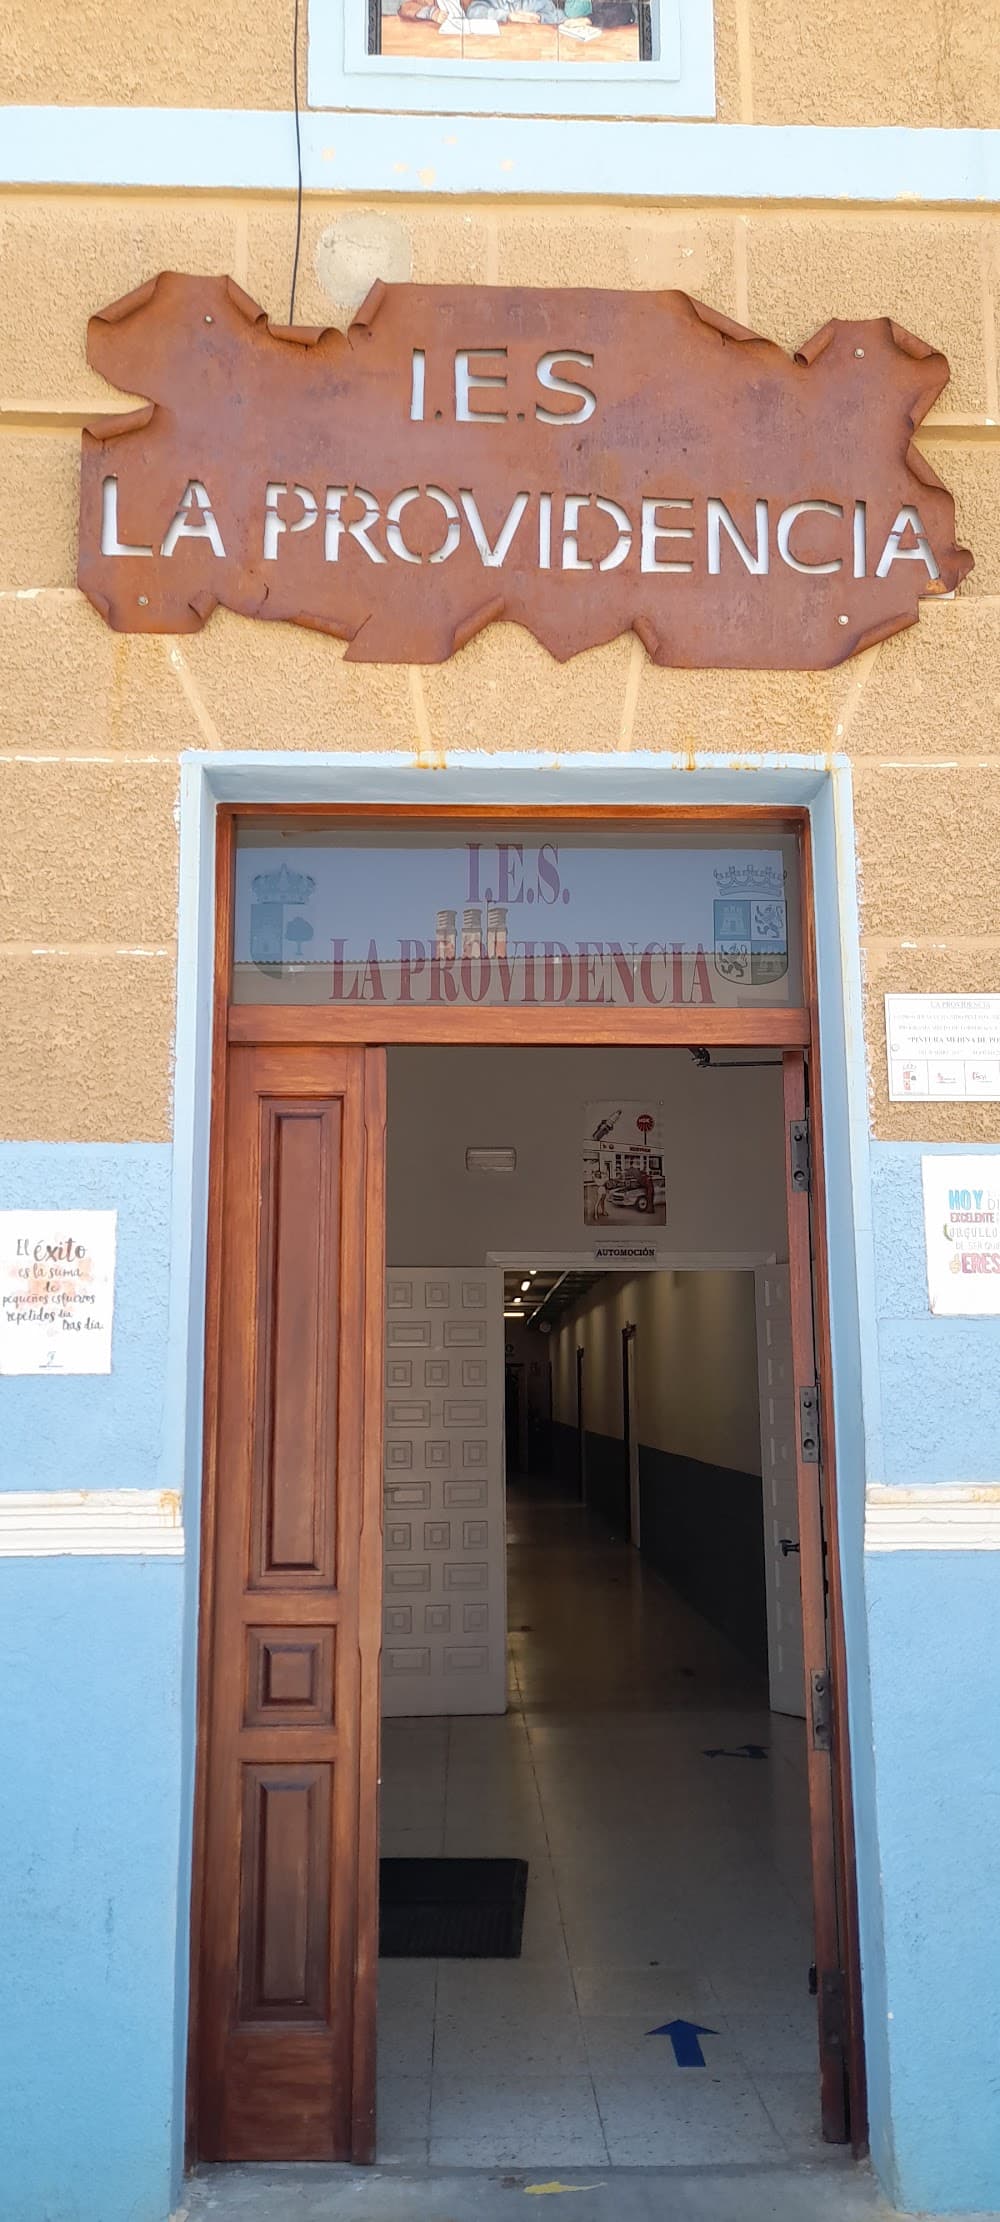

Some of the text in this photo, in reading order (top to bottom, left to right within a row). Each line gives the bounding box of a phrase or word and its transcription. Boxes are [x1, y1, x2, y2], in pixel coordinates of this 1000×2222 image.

[410, 347, 597, 426] I.E.S
[101, 474, 941, 580] LA PROVIDENCIA
[464, 841, 571, 905] I.E.S.
[328, 936, 717, 1005] LA PROVIDENCIA
[949, 1190, 984, 1211] HOY
[950, 1212, 995, 1224] EXCELENTE
[949, 1227, 1000, 1240] ORGULLO
[16, 1237, 87, 1262] El éxito
[596, 1248, 655, 1257] AUTOMOCIÓN
[18, 1263, 83, 1279] es la suma
[44, 1281, 60, 1293] de
[2, 1293, 96, 1309] pequeños esfuerzos
[6, 1307, 56, 1325] repetidos
